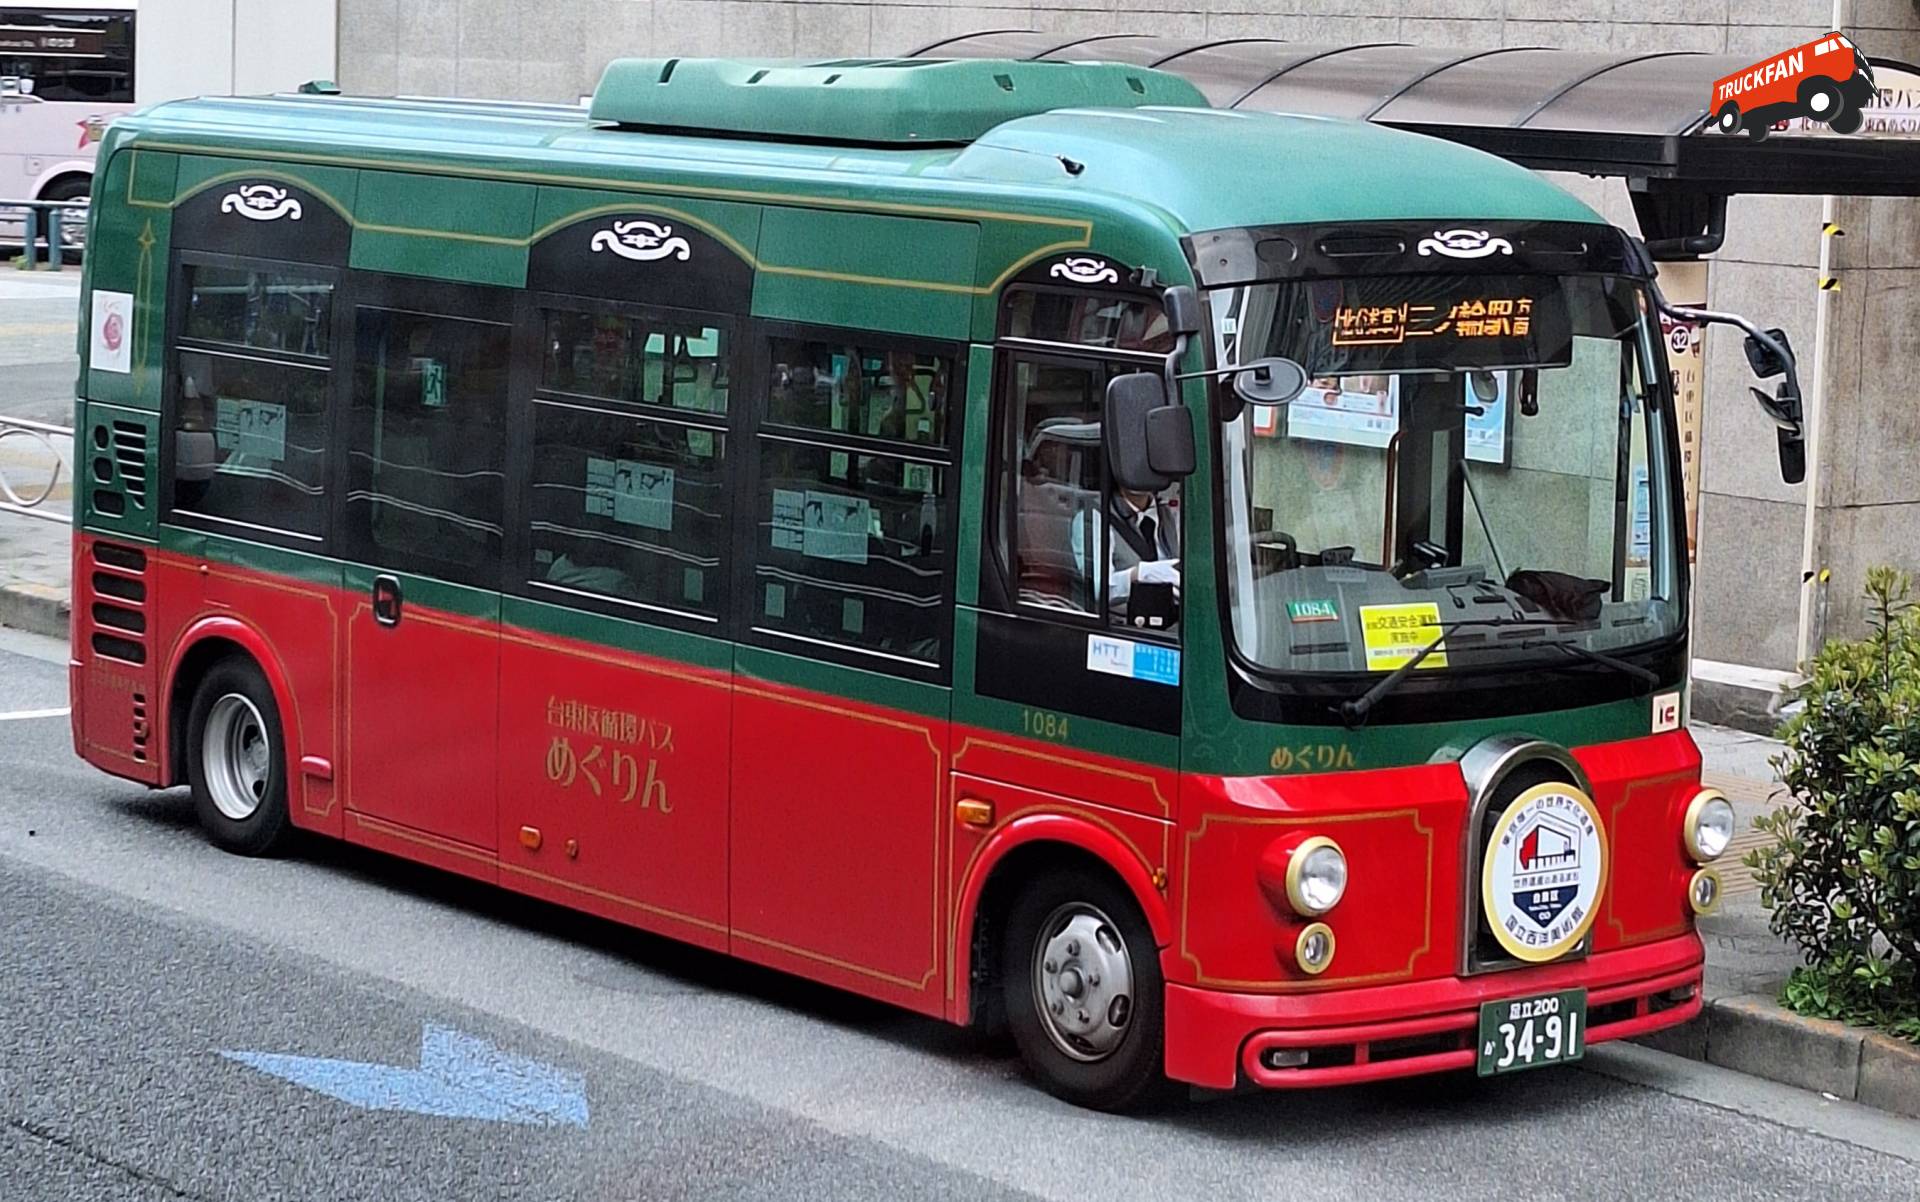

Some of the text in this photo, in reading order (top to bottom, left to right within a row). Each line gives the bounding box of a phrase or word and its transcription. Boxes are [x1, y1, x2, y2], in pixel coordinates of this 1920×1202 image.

[1673, 332, 1687, 349] 32
[1294, 602, 1330, 616] 1084
[1093, 641, 1120, 658] HTT
[547, 695, 674, 753] 台東区循環バス
[1023, 709, 1069, 740] 1084
[1270, 743, 1355, 770] めぐりん
[547, 736, 673, 814] めぐりん
[1498, 1010, 1577, 1067] 34-91
